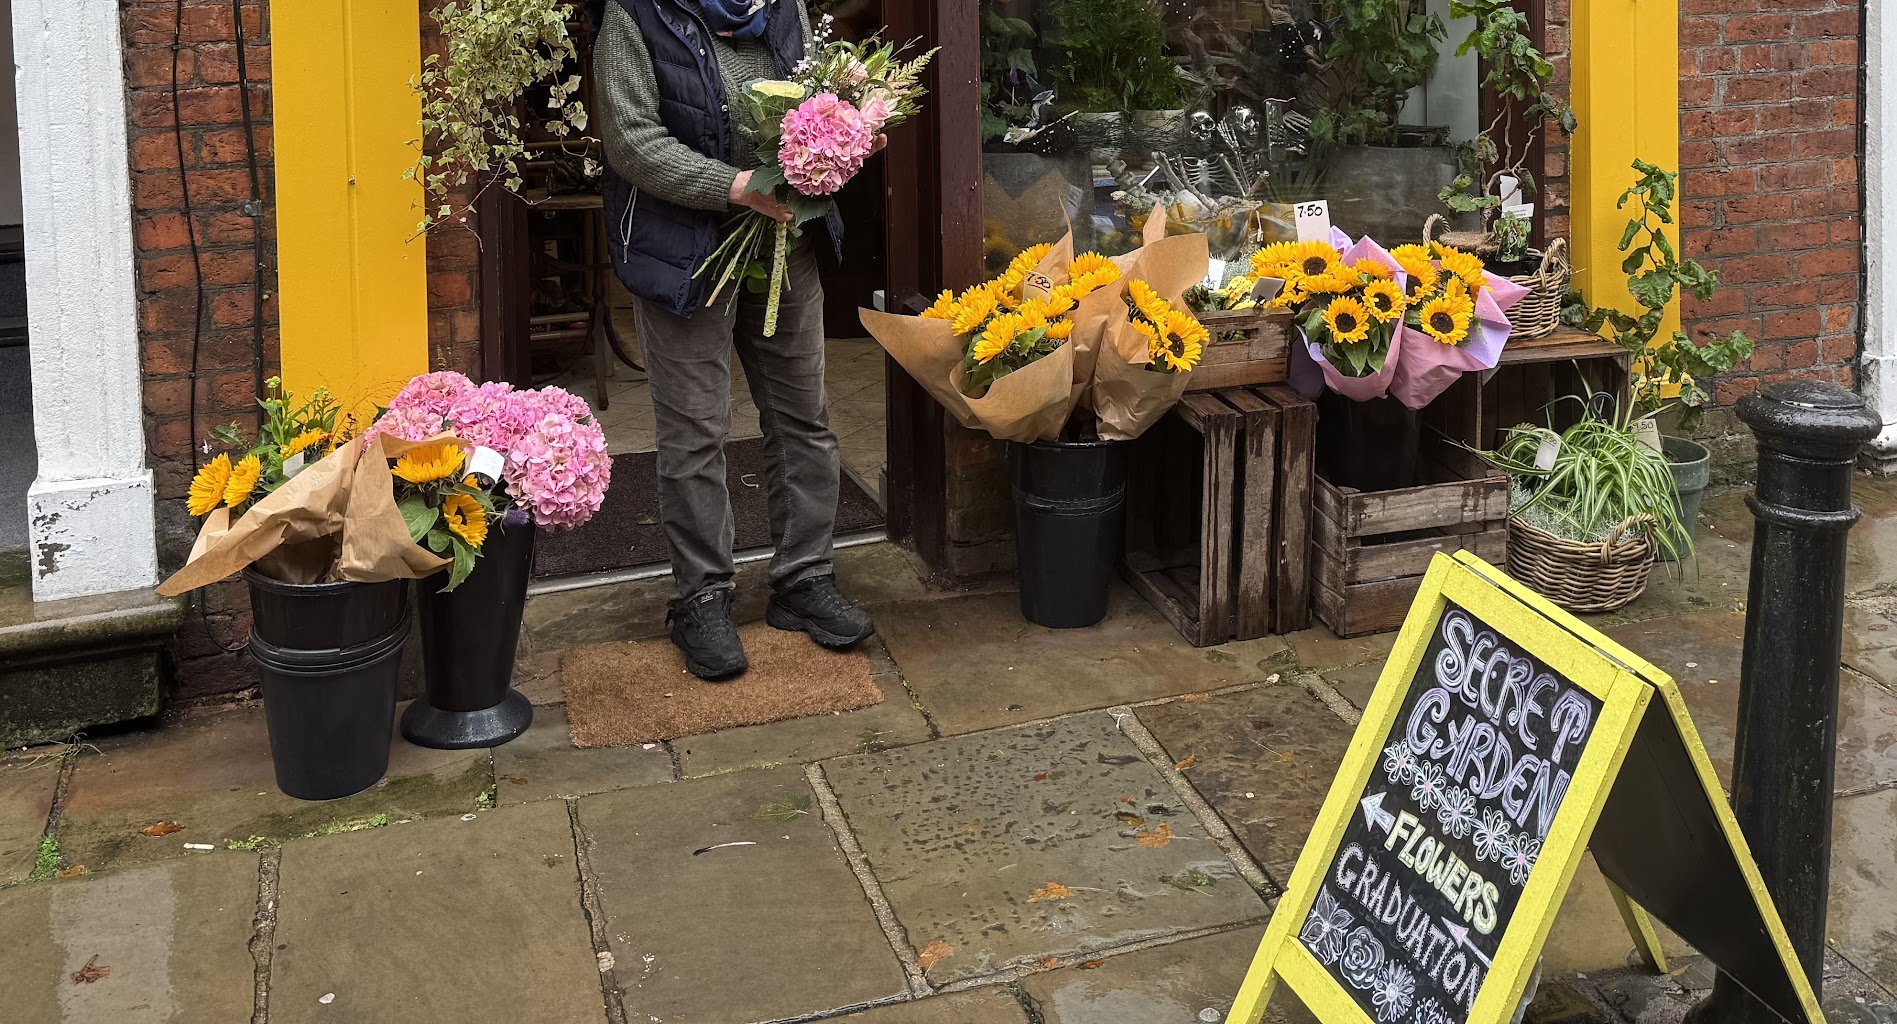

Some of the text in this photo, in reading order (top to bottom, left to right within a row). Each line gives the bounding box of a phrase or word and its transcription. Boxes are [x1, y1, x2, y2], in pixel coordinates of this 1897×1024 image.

[1434, 610, 1592, 764] SECRET
[1406, 687, 1570, 842] GARDEN
[1335, 841, 1489, 1015] GRADUATION
[1384, 810, 1500, 935] FLOWERS
